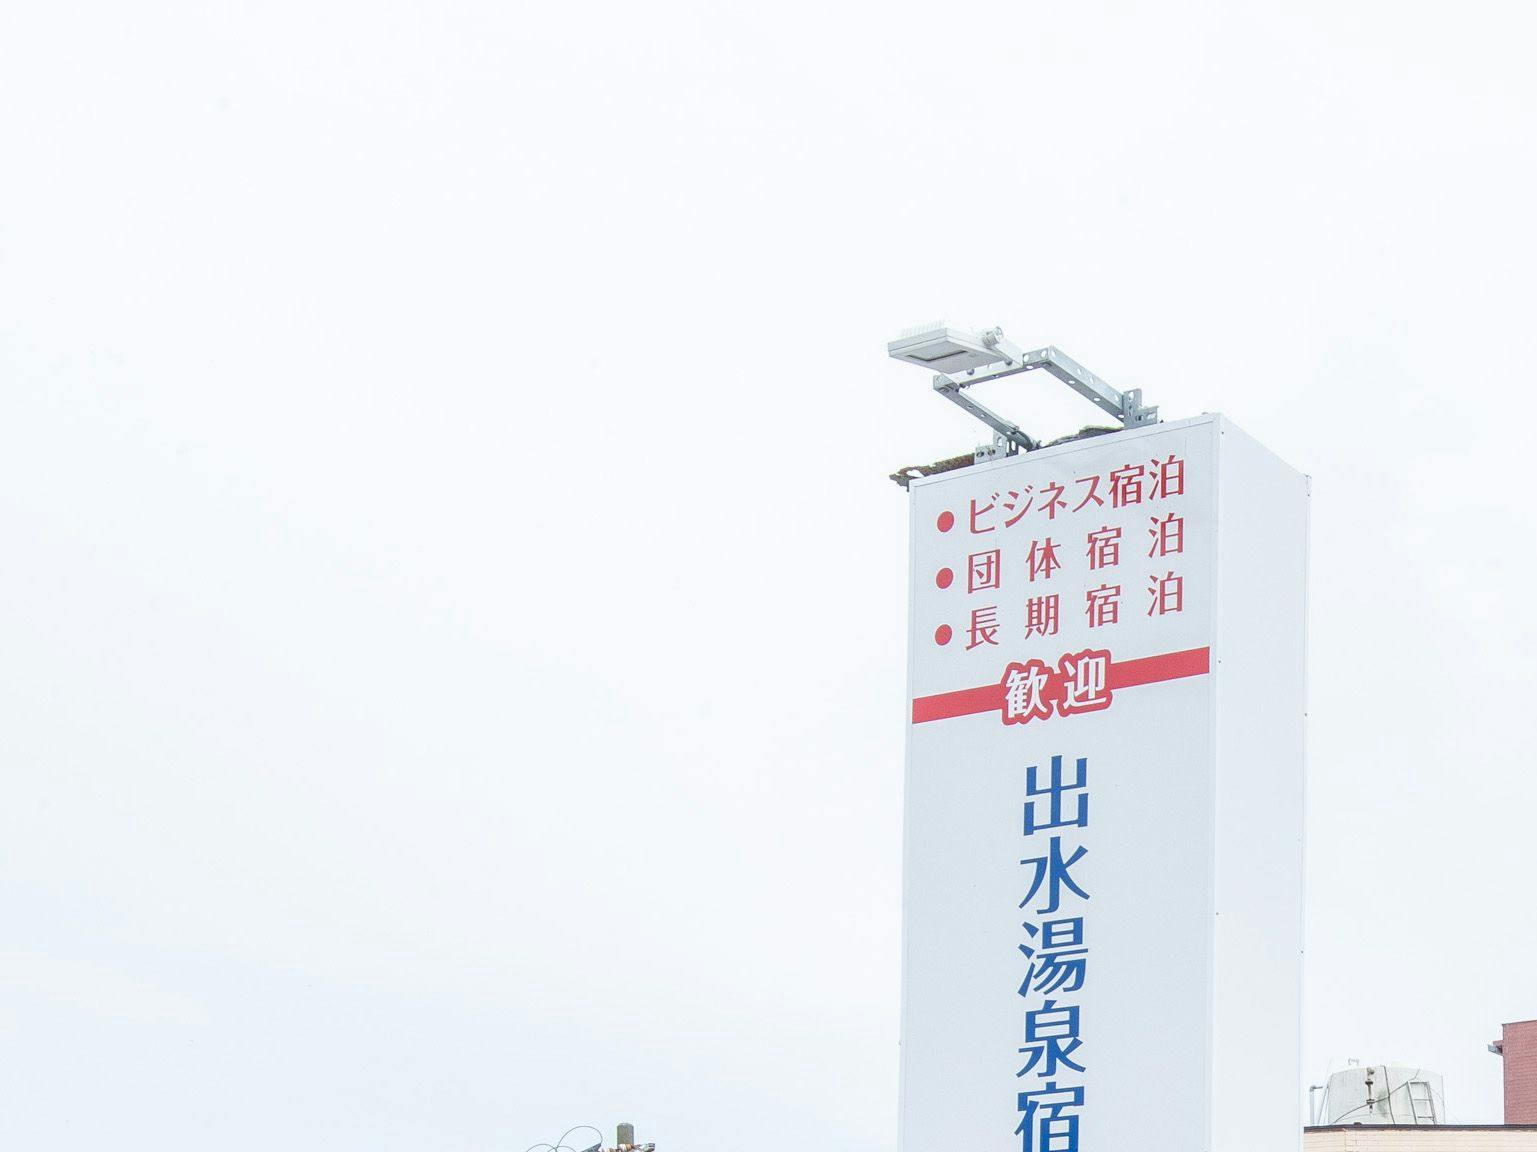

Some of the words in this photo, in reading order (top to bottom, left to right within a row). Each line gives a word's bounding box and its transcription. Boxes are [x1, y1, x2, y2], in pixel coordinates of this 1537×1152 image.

[970, 454, 1184, 534] ビジネス宿泊
[967, 512, 1184, 593] 団体宿泊
[966, 571, 1183, 650] 長期宿泊
[1004, 655, 1107, 719] 歓迎
